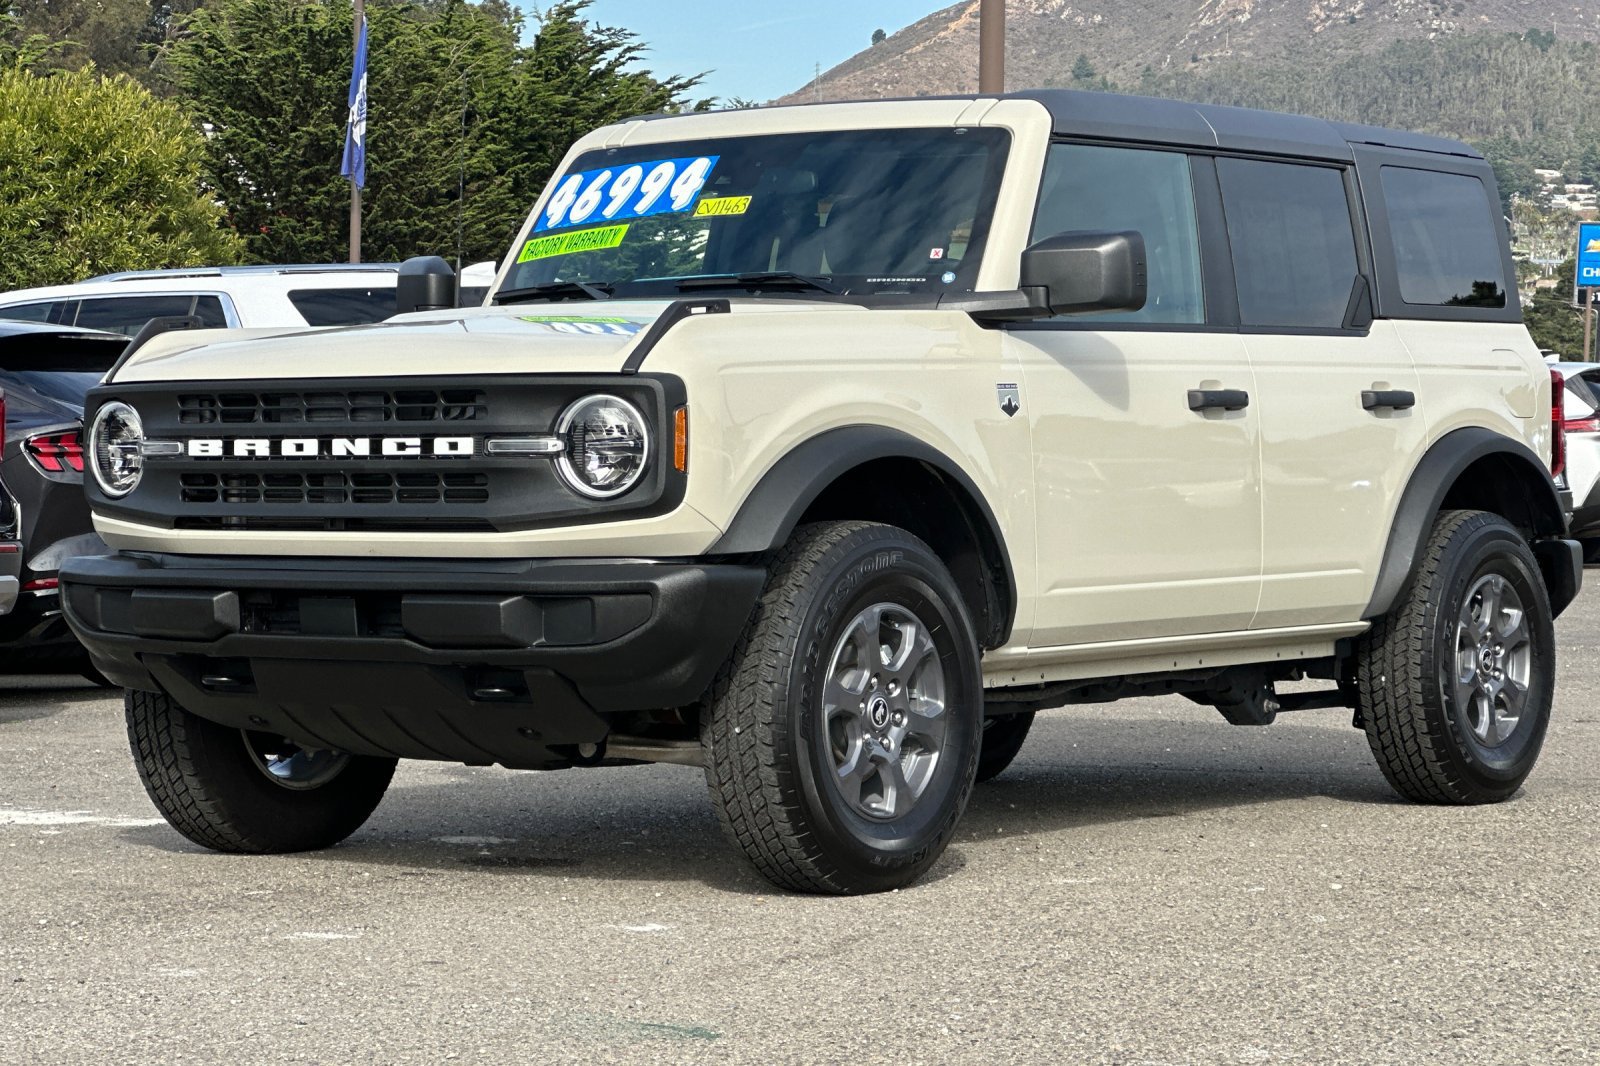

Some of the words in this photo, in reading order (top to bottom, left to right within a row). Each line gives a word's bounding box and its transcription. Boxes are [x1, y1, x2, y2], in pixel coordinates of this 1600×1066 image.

[546, 157, 712, 228] 46994
[524, 235, 568, 260] FACTORY
[564, 227, 622, 251] WARRANTY
[188, 437, 474, 457] BRONCO
